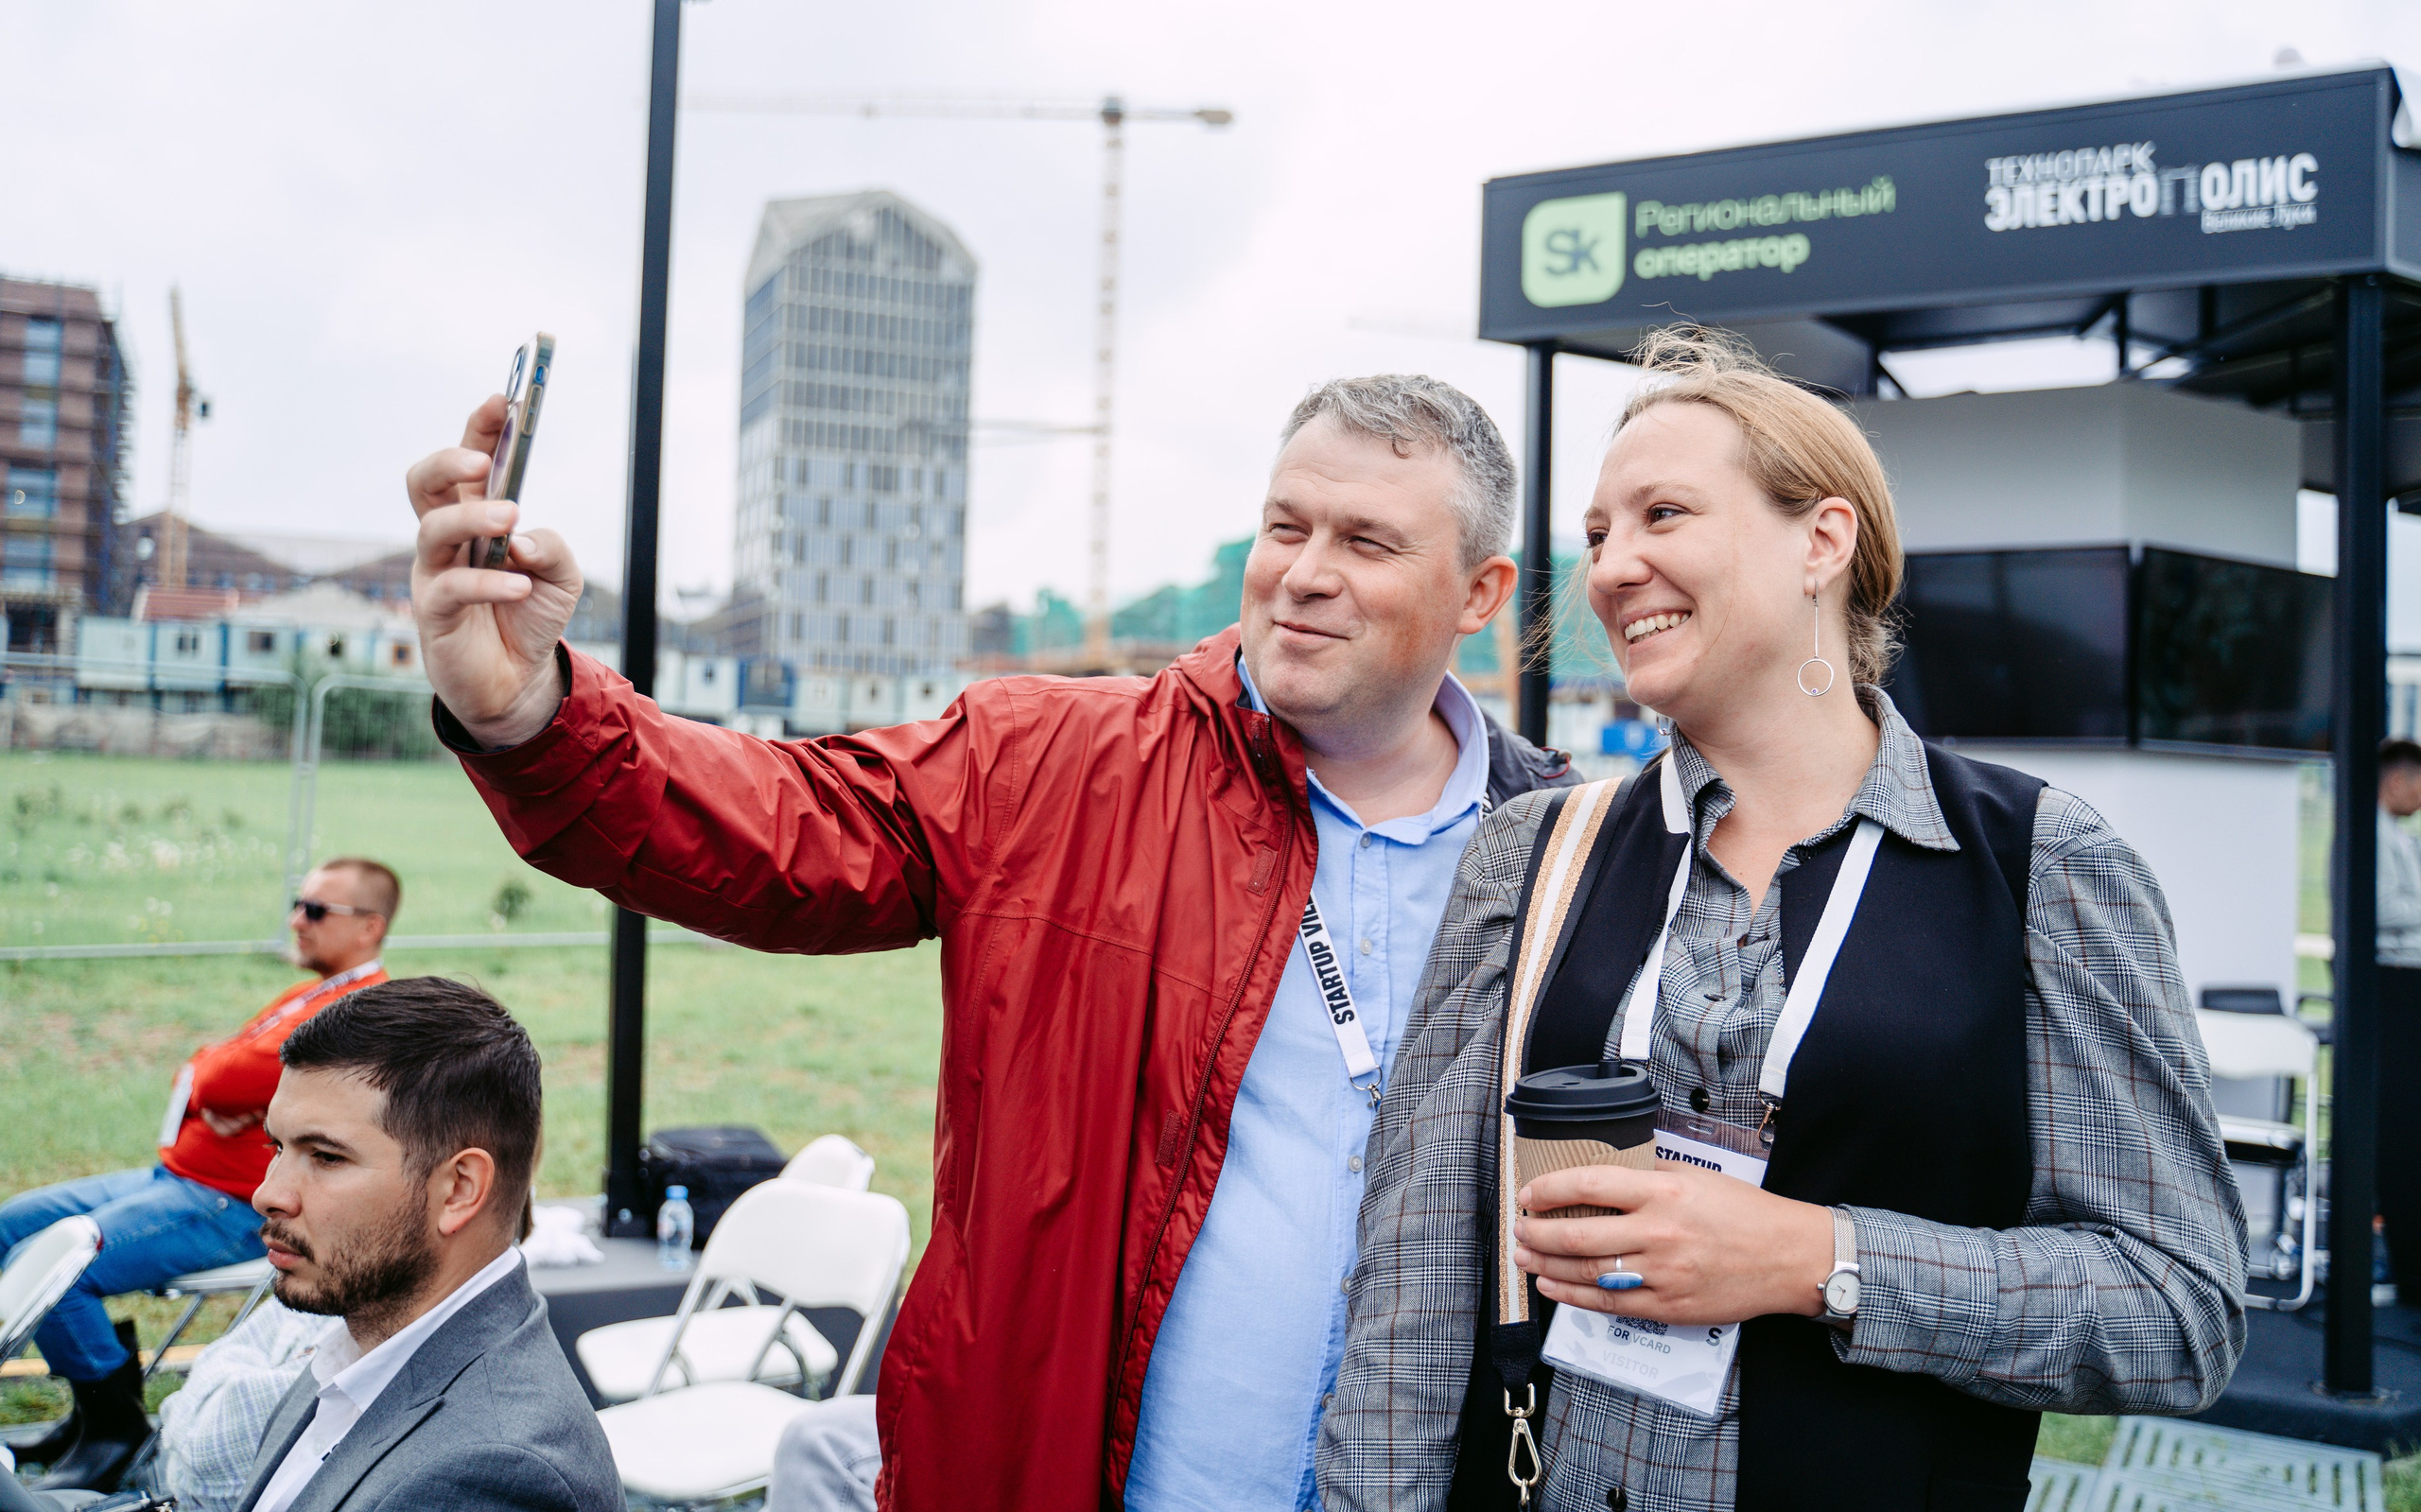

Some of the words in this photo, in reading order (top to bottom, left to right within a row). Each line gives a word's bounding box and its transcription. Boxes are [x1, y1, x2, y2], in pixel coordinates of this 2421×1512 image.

[1985, 142, 2156, 186] ТЕХНОПАРК
[1635, 174, 1896, 237] Региональный
[1544, 228, 1600, 277] Sk
[1633, 233, 1810, 281] оператор
[1309, 941, 1355, 1025] STARTUP
[1608, 1326, 1629, 1340] FOR
[1632, 1333, 1671, 1354] VCARD
[1706, 1327, 1722, 1347] S
[1602, 1350, 1659, 1379] VISITOR
